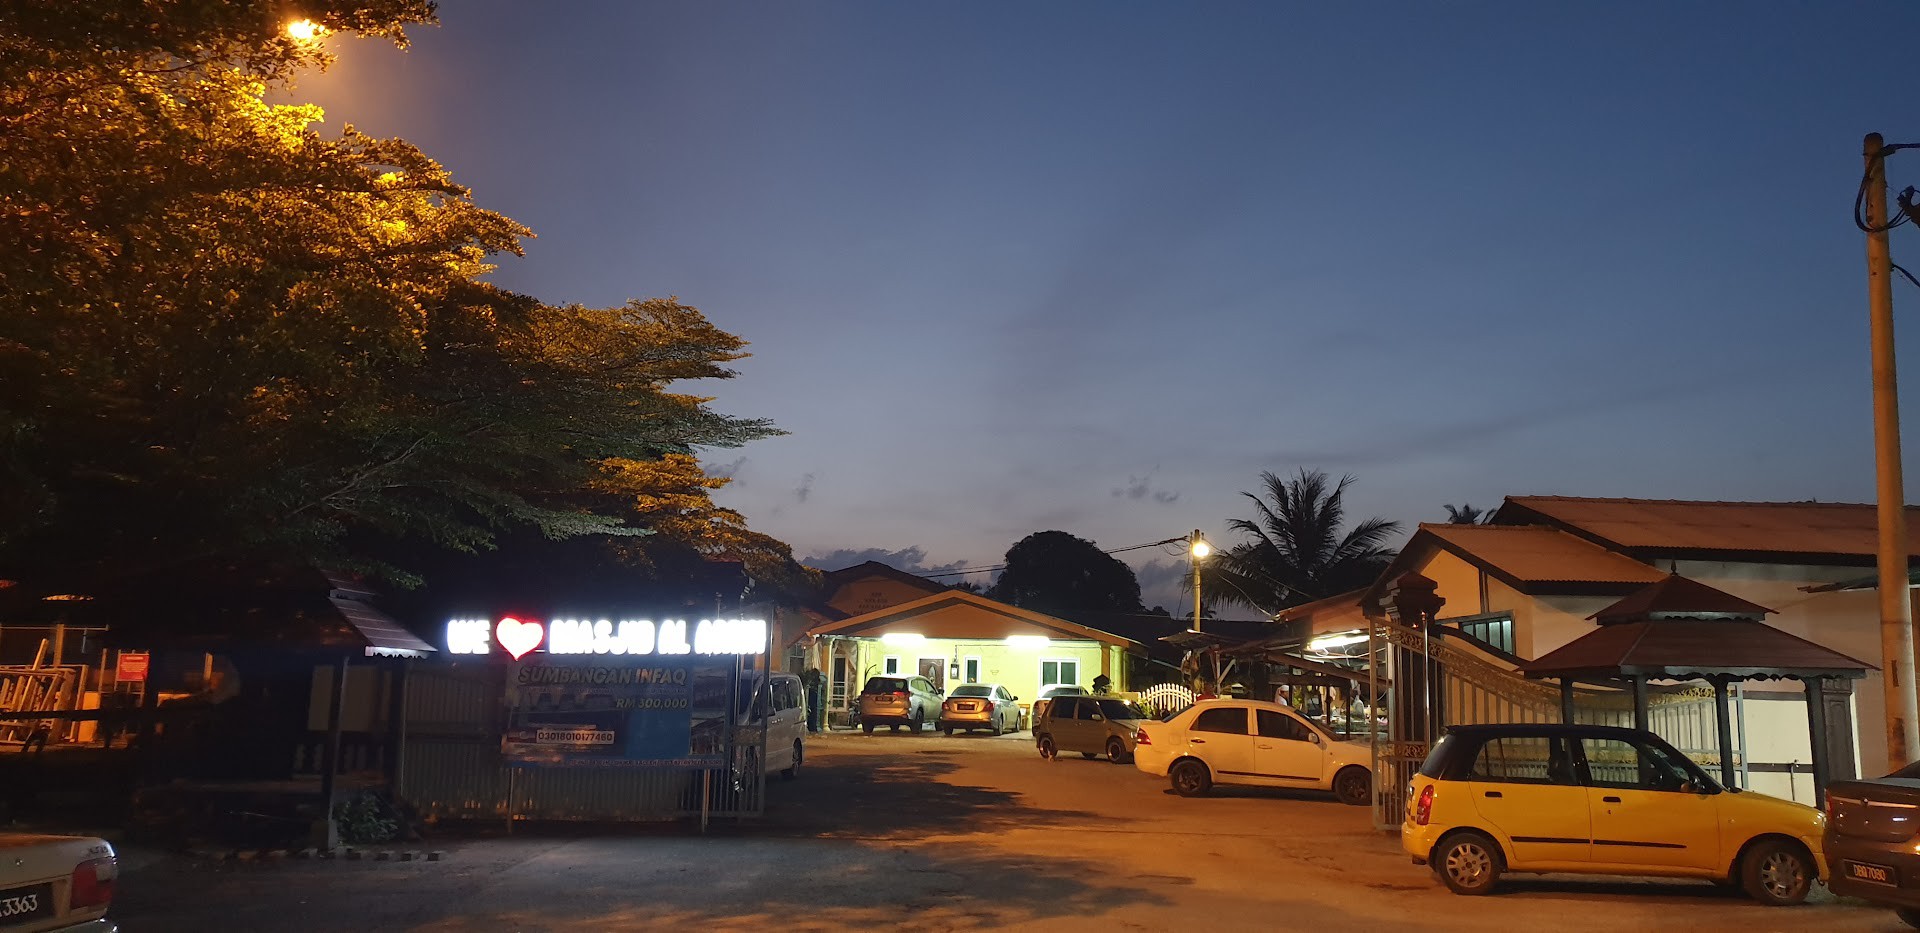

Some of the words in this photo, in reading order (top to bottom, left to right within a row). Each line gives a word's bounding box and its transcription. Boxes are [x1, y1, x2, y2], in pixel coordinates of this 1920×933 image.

[447, 619, 490, 654] WE
[549, 619, 655, 654] MASJID
[658, 619, 690, 654] AL
[518, 666, 632, 685] SUMBANGAN
[635, 666, 688, 686] INFAQ
[616, 698, 635, 709] RM
[537, 732, 613, 742] 03018010177460
